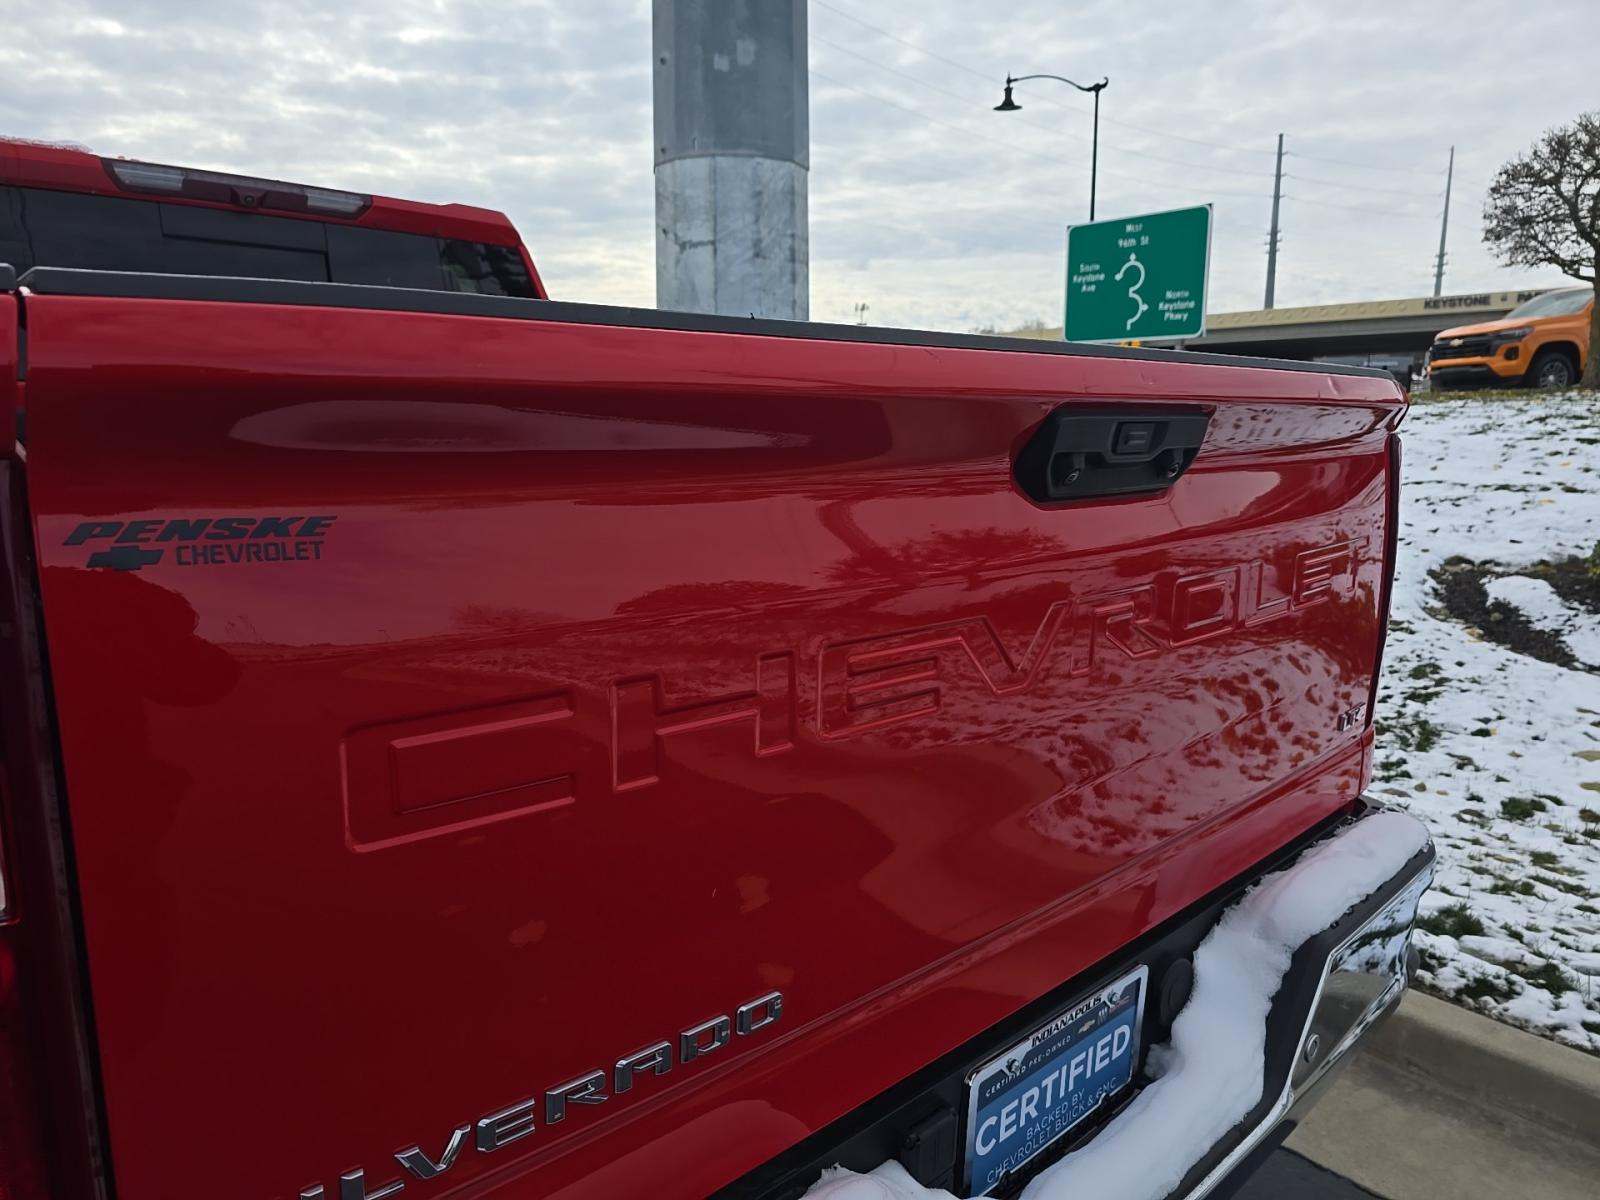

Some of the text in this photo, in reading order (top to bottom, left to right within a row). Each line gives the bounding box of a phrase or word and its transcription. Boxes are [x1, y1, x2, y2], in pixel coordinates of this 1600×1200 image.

[1140, 235, 1149, 246] St
[1080, 263, 1100, 273] South
[1073, 273, 1105, 284] Keystone
[1081, 284, 1096, 293] Ave
[1166, 290, 1189, 299] North
[1424, 295, 1490, 309] KEYSTONE
[1158, 300, 1195, 311] Keystone
[1164, 311, 1188, 322] Pkwy
[63, 515, 338, 546] PENSKE
[176, 540, 324, 566] CHEVROLET
[340, 536, 1370, 854] CHEVROLET
[1031, 995, 1103, 1048] INDIANAPOLIS
[1029, 1035, 1071, 1068] PRE-OWNED
[975, 1024, 1132, 1156] CERTIFIED
[1026, 1087, 1085, 1141] BACKED BY
[1055, 1105, 1085, 1132] BUICK
[1088, 1094, 1095, 1106] &
